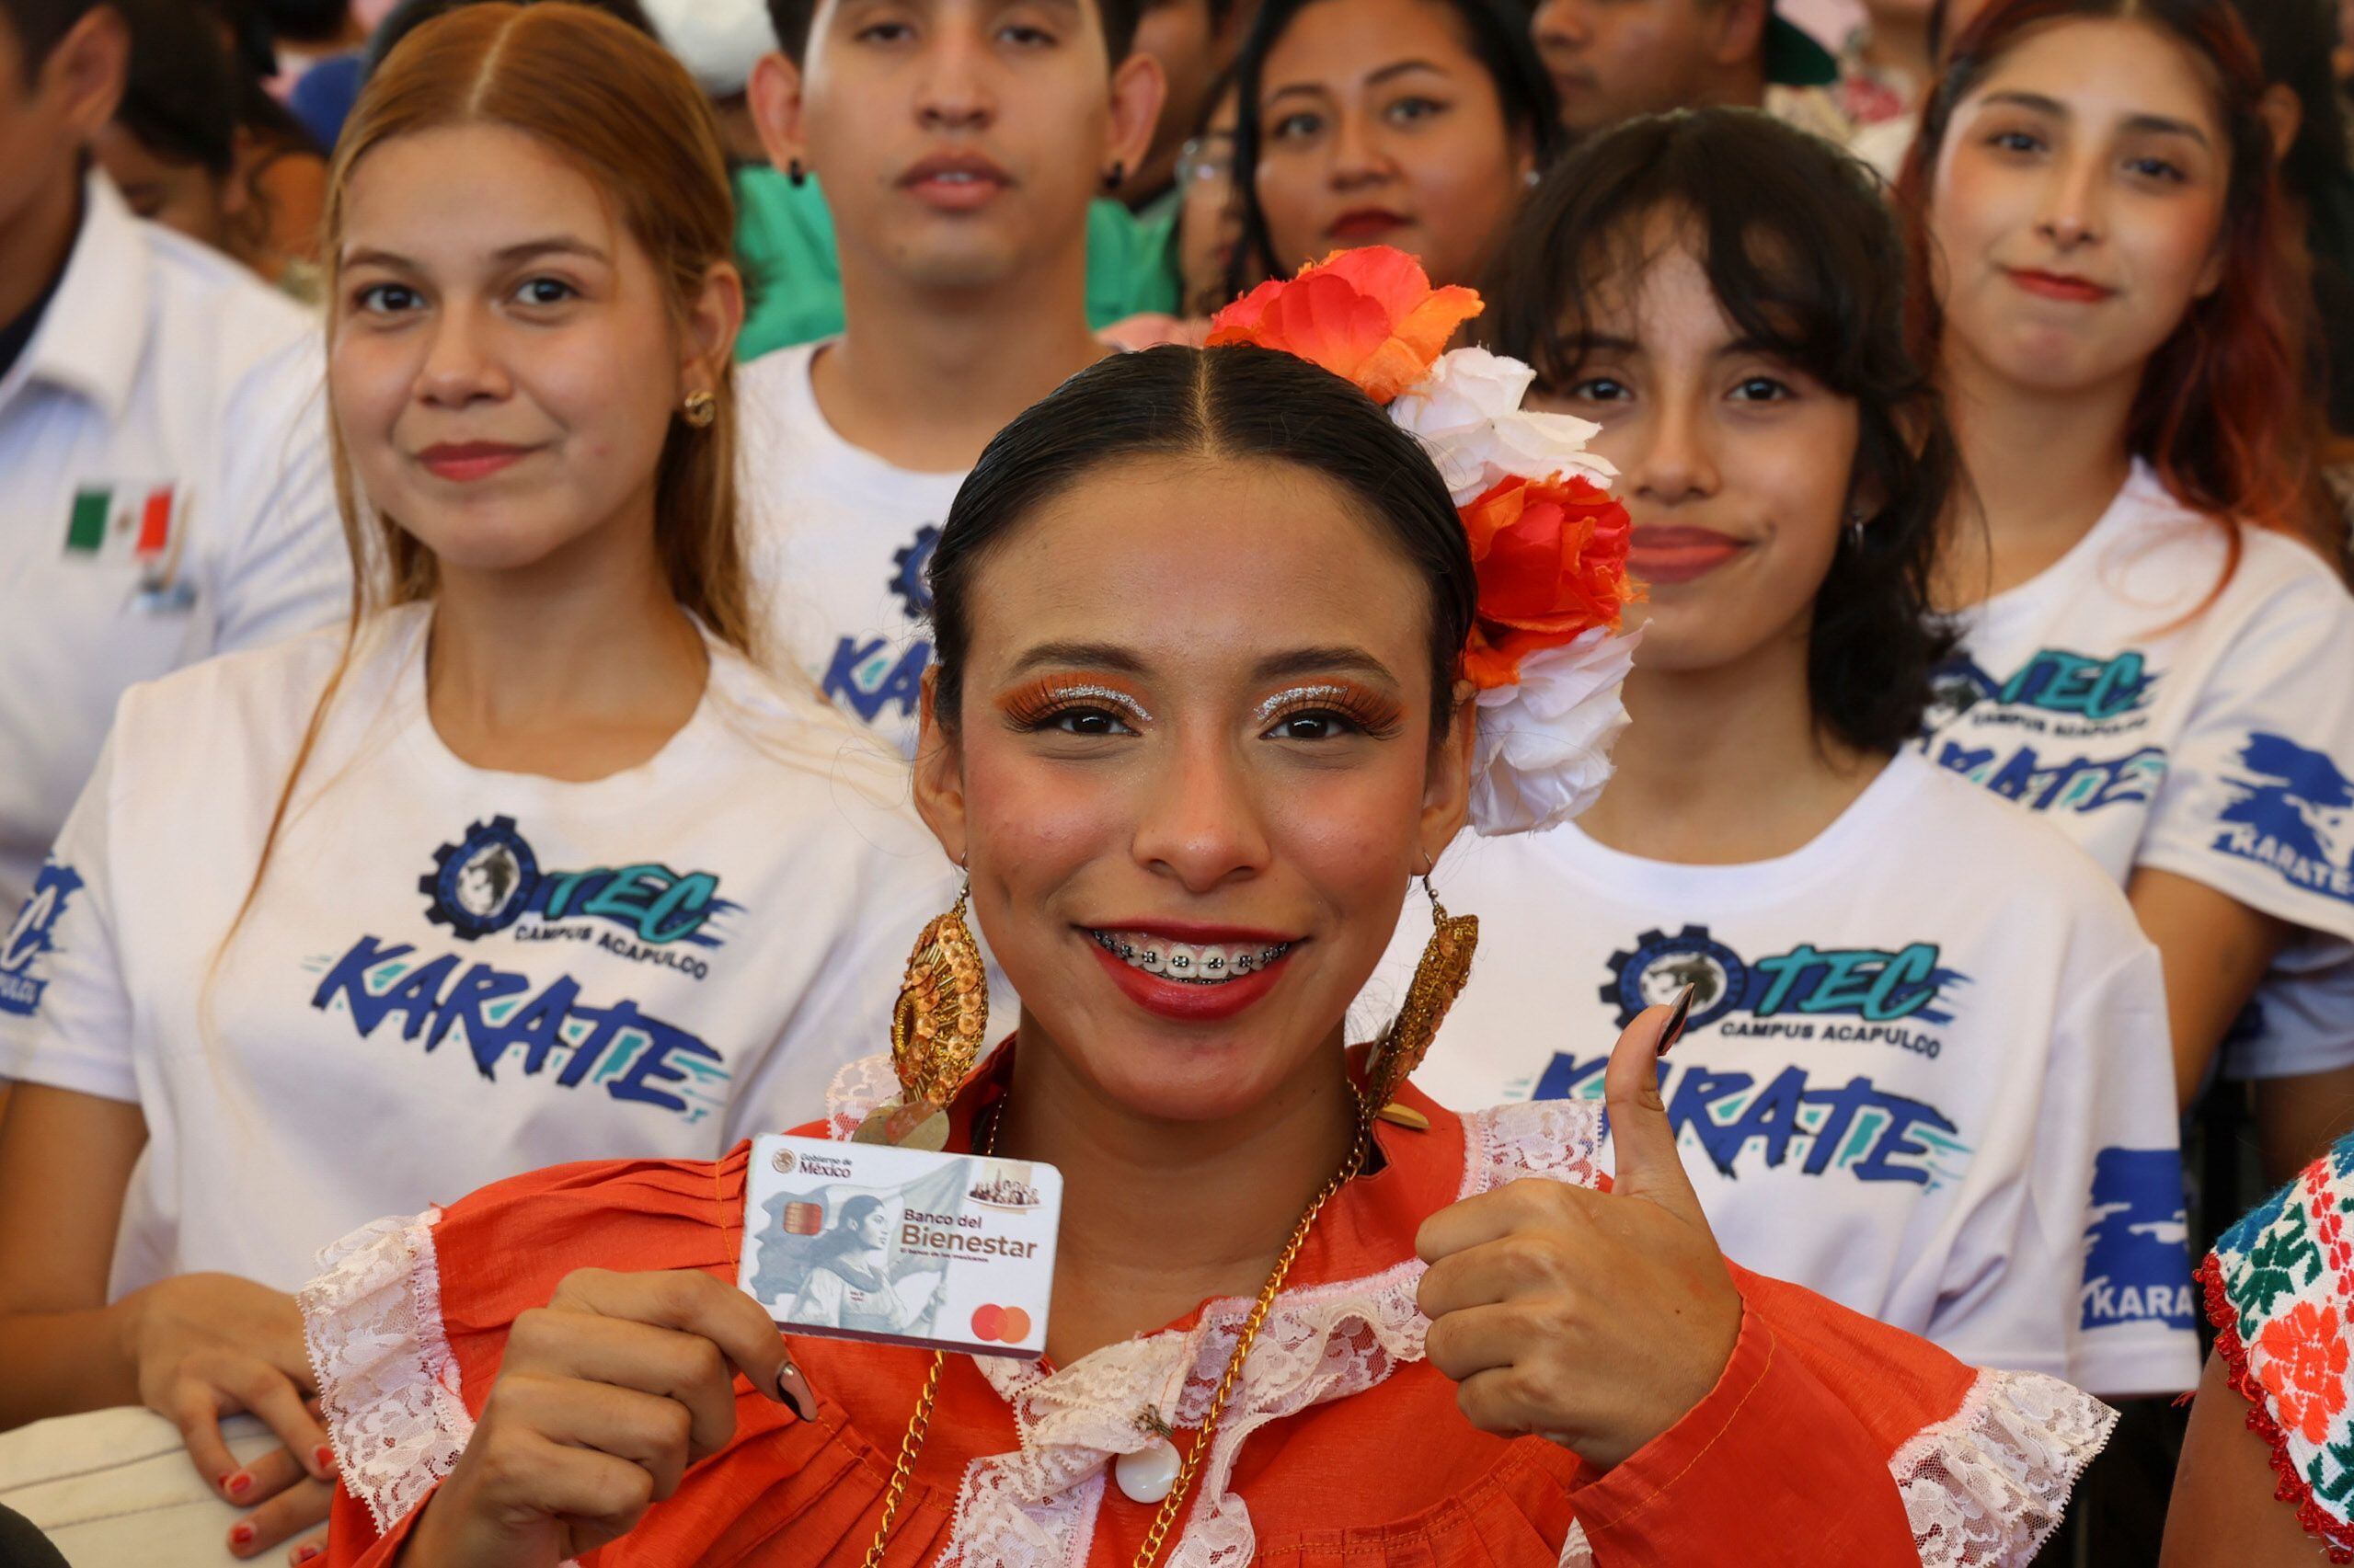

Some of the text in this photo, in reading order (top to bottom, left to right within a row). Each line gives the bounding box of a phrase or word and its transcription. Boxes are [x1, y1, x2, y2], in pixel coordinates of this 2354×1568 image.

[1996, 648, 2145, 720] TEC
[1938, 740, 2166, 813] RATE
[2230, 829, 2350, 896] KARATE
[543, 863, 720, 945] TEC
[515, 923, 708, 980] CAMPUS ACAPULCO
[1753, 942, 1940, 1022] TEC
[312, 934, 723, 1111] KARATE
[1720, 1022, 1941, 1059] CAMPUS ACAPULCO
[1532, 1052, 1958, 1185] KRATE
[799, 1161, 851, 1178] México
[901, 1223, 1038, 1259] Bienestar
[904, 1208, 982, 1229] Banco del
[2092, 1286, 2194, 1317] KARA
